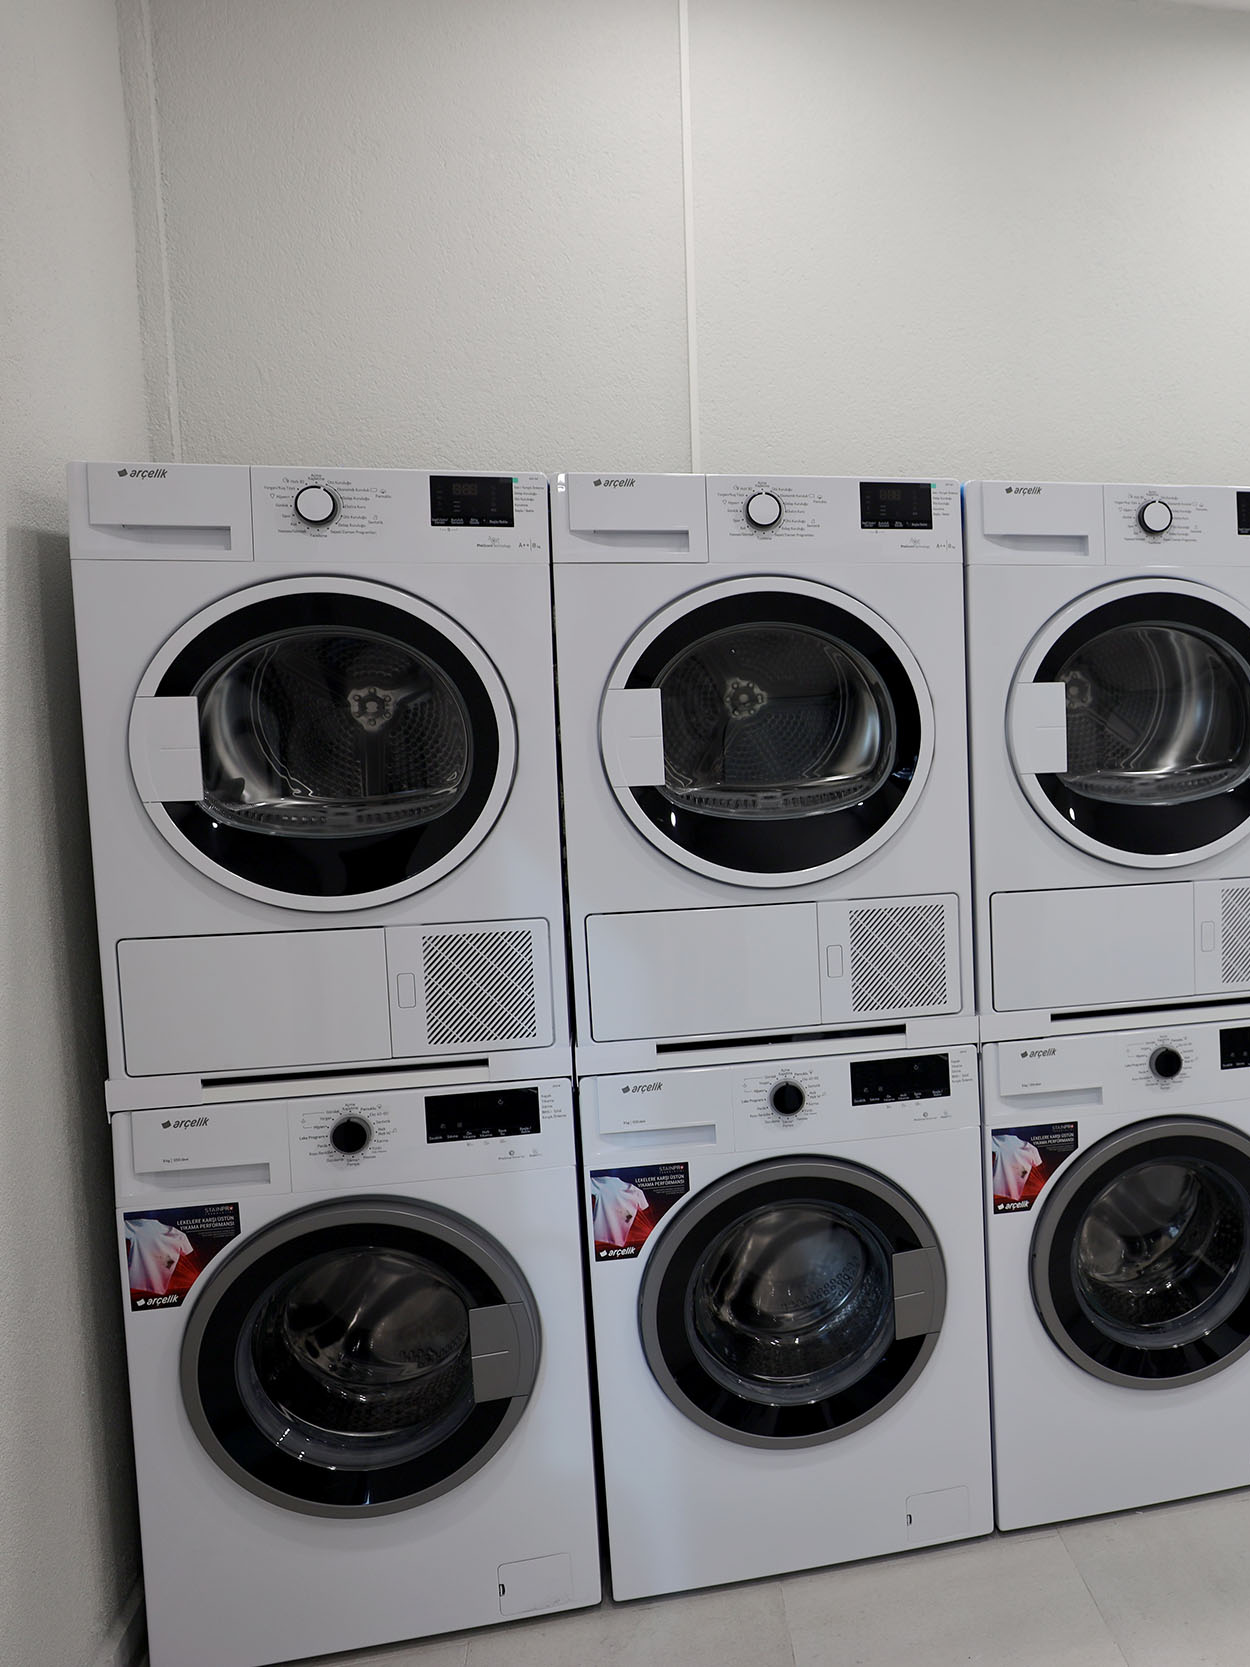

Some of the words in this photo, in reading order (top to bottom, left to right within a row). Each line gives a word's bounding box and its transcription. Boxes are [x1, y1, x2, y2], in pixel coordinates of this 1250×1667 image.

[130, 468, 168, 480] arçelik
[603, 478, 636, 488] arçelik
[1014, 486, 1042, 497] arçelik
[1029, 1048, 1056, 1058] arçelik
[632, 1082, 664, 1094] arçelik
[172, 1117, 209, 1130] arçelik
[1005, 1200, 1030, 1210] arçelik
[200, 1221, 235, 1229] PERFORMANSI
[608, 1246, 636, 1257] arçelik
[147, 1294, 179, 1306] arçelik
